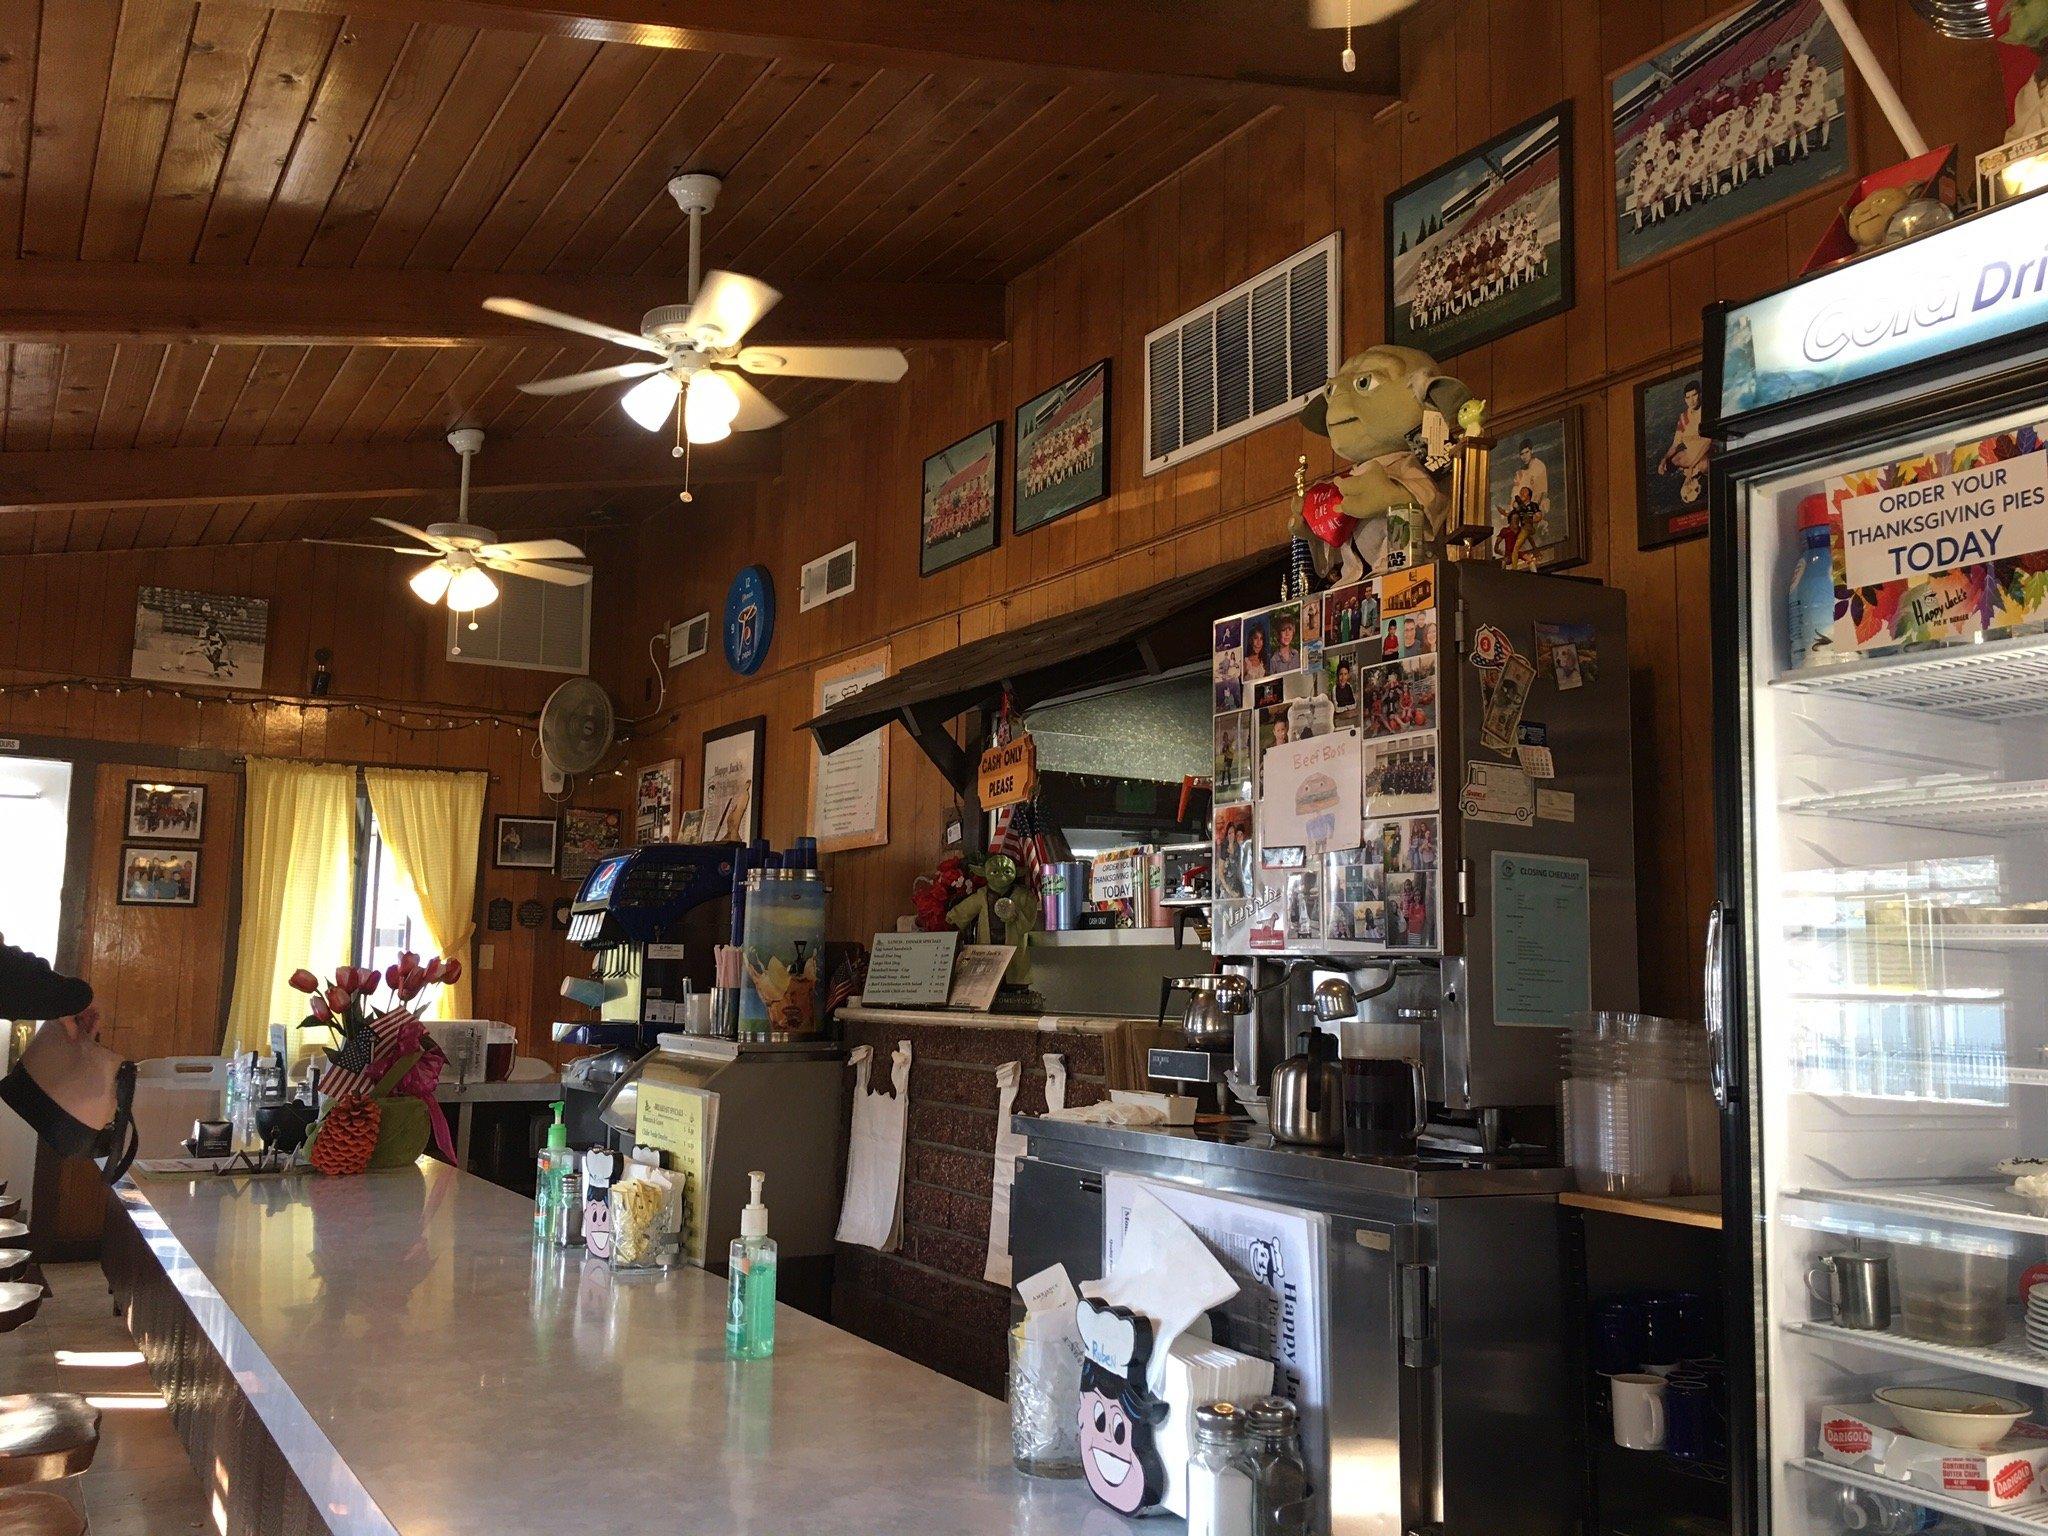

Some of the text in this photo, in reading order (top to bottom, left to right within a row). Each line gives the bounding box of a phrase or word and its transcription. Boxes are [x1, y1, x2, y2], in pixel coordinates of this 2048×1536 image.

[1878, 466, 2008, 515] ORDER YOUR
[1847, 486, 2046, 547] THANKSGIVING PIES
[1887, 525, 2004, 576] TODAY
[1911, 588, 1968, 626] Happy Jack's
[982, 745, 1023, 774] CASH ONLY
[1293, 742, 1346, 770] Beef Boss
[988, 776, 1014, 798] PLEASE
[1094, 872, 1130, 884] THANKSGIVING
[1102, 863, 1120, 872] ORDER
[1520, 867, 1580, 880] CLOSING CHECKLIST
[1102, 883, 1131, 898] TODAY
[1283, 1282, 1297, 1363] Happy
[1827, 1429, 1870, 1443] DARIGOLD
[1943, 1462, 1978, 1470] CONTINENTAL
[1943, 1470, 1963, 1478] BUTTER
[1995, 1465, 2031, 1496] DARIGOLD
